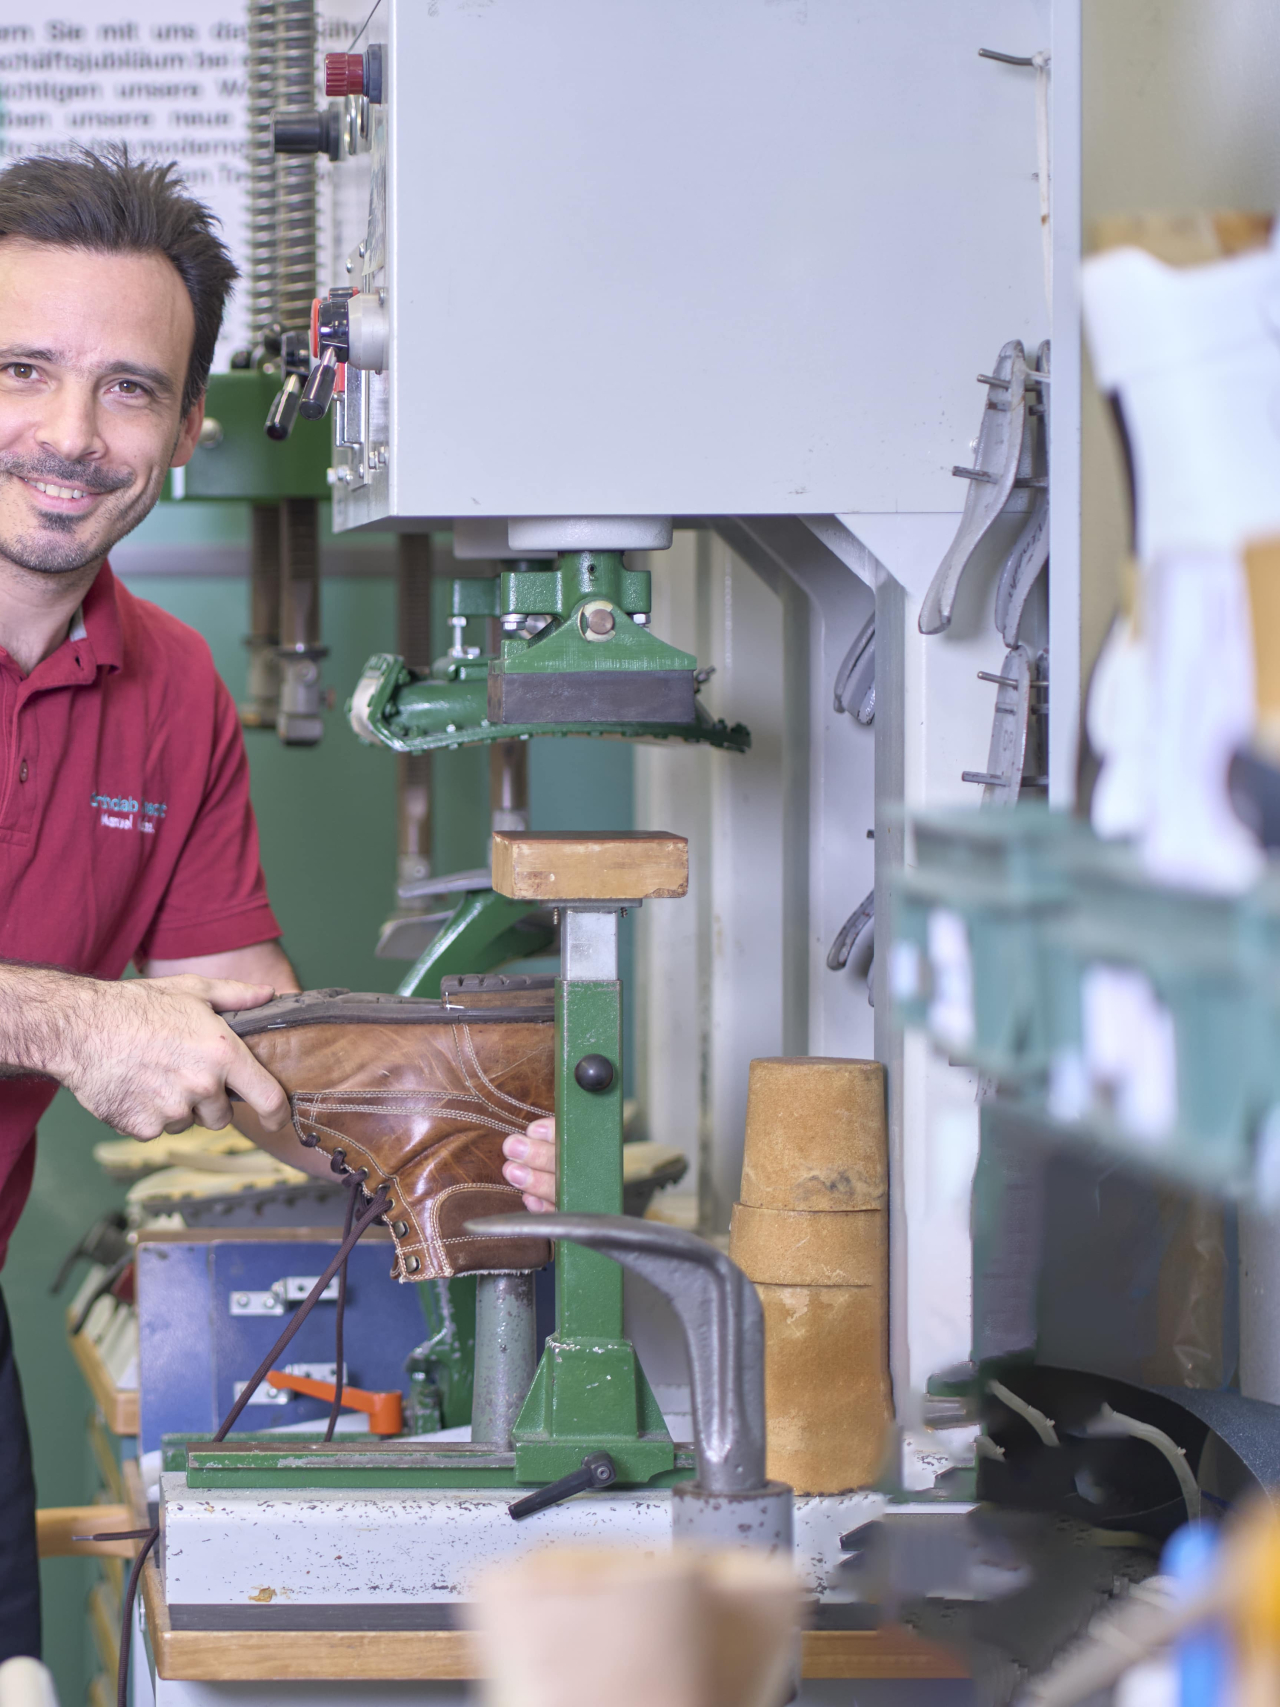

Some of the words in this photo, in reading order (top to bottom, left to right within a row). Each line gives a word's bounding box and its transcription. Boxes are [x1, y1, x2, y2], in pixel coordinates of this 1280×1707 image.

[46, 20, 86, 42] Sie
[98, 20, 138, 42] mit
[152, 23, 197, 42] uns
